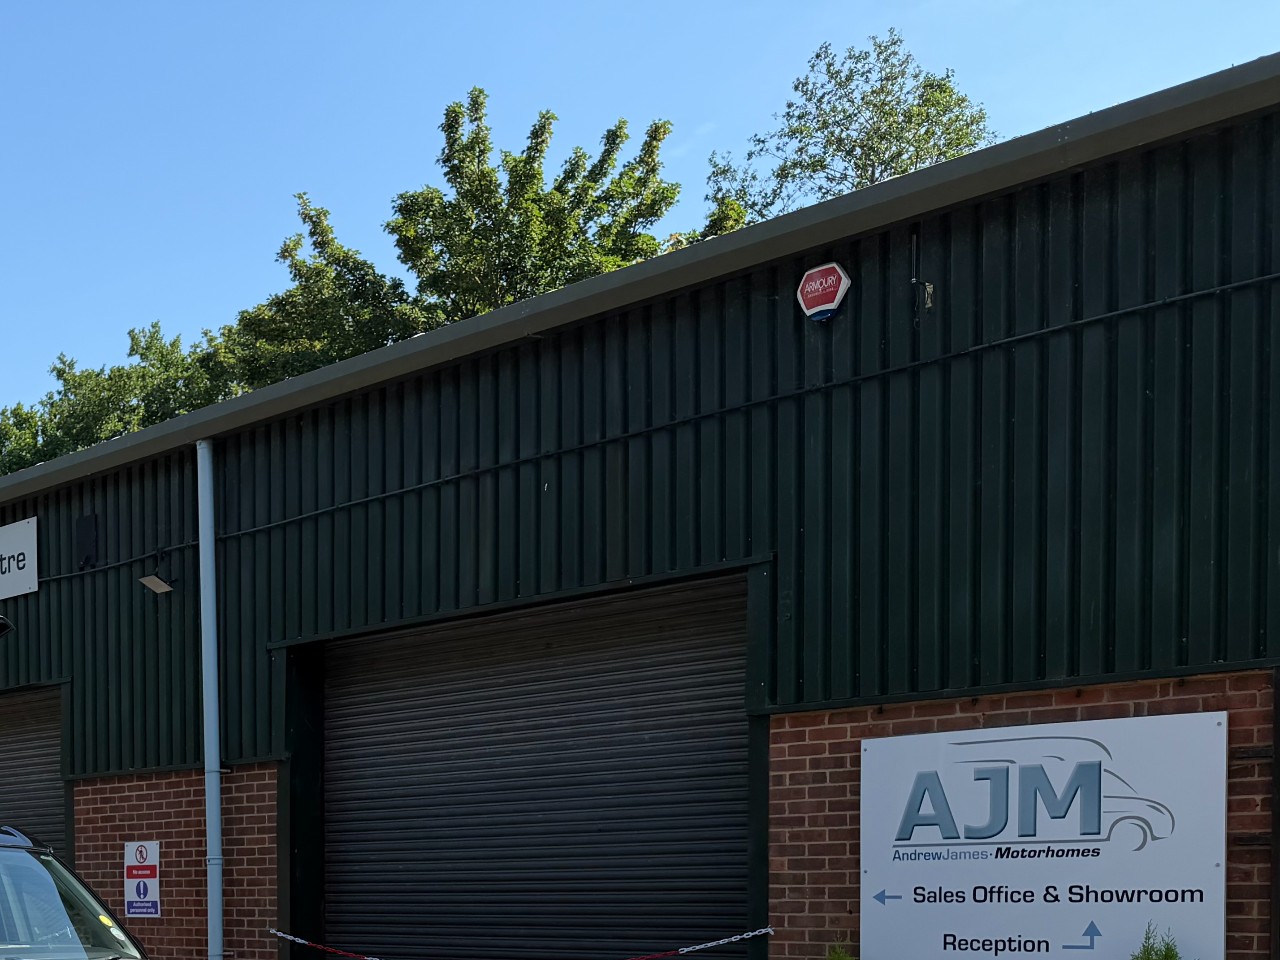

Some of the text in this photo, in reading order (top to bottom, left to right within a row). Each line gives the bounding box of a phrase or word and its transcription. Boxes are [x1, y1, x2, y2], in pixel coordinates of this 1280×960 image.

[804, 275, 837, 293] ARMOURY
[894, 760, 1102, 841] AJM
[994, 846, 1101, 860] Motorhomes
[913, 884, 1204, 904] Sales Office & Showroom
[943, 933, 1050, 957] Reception
